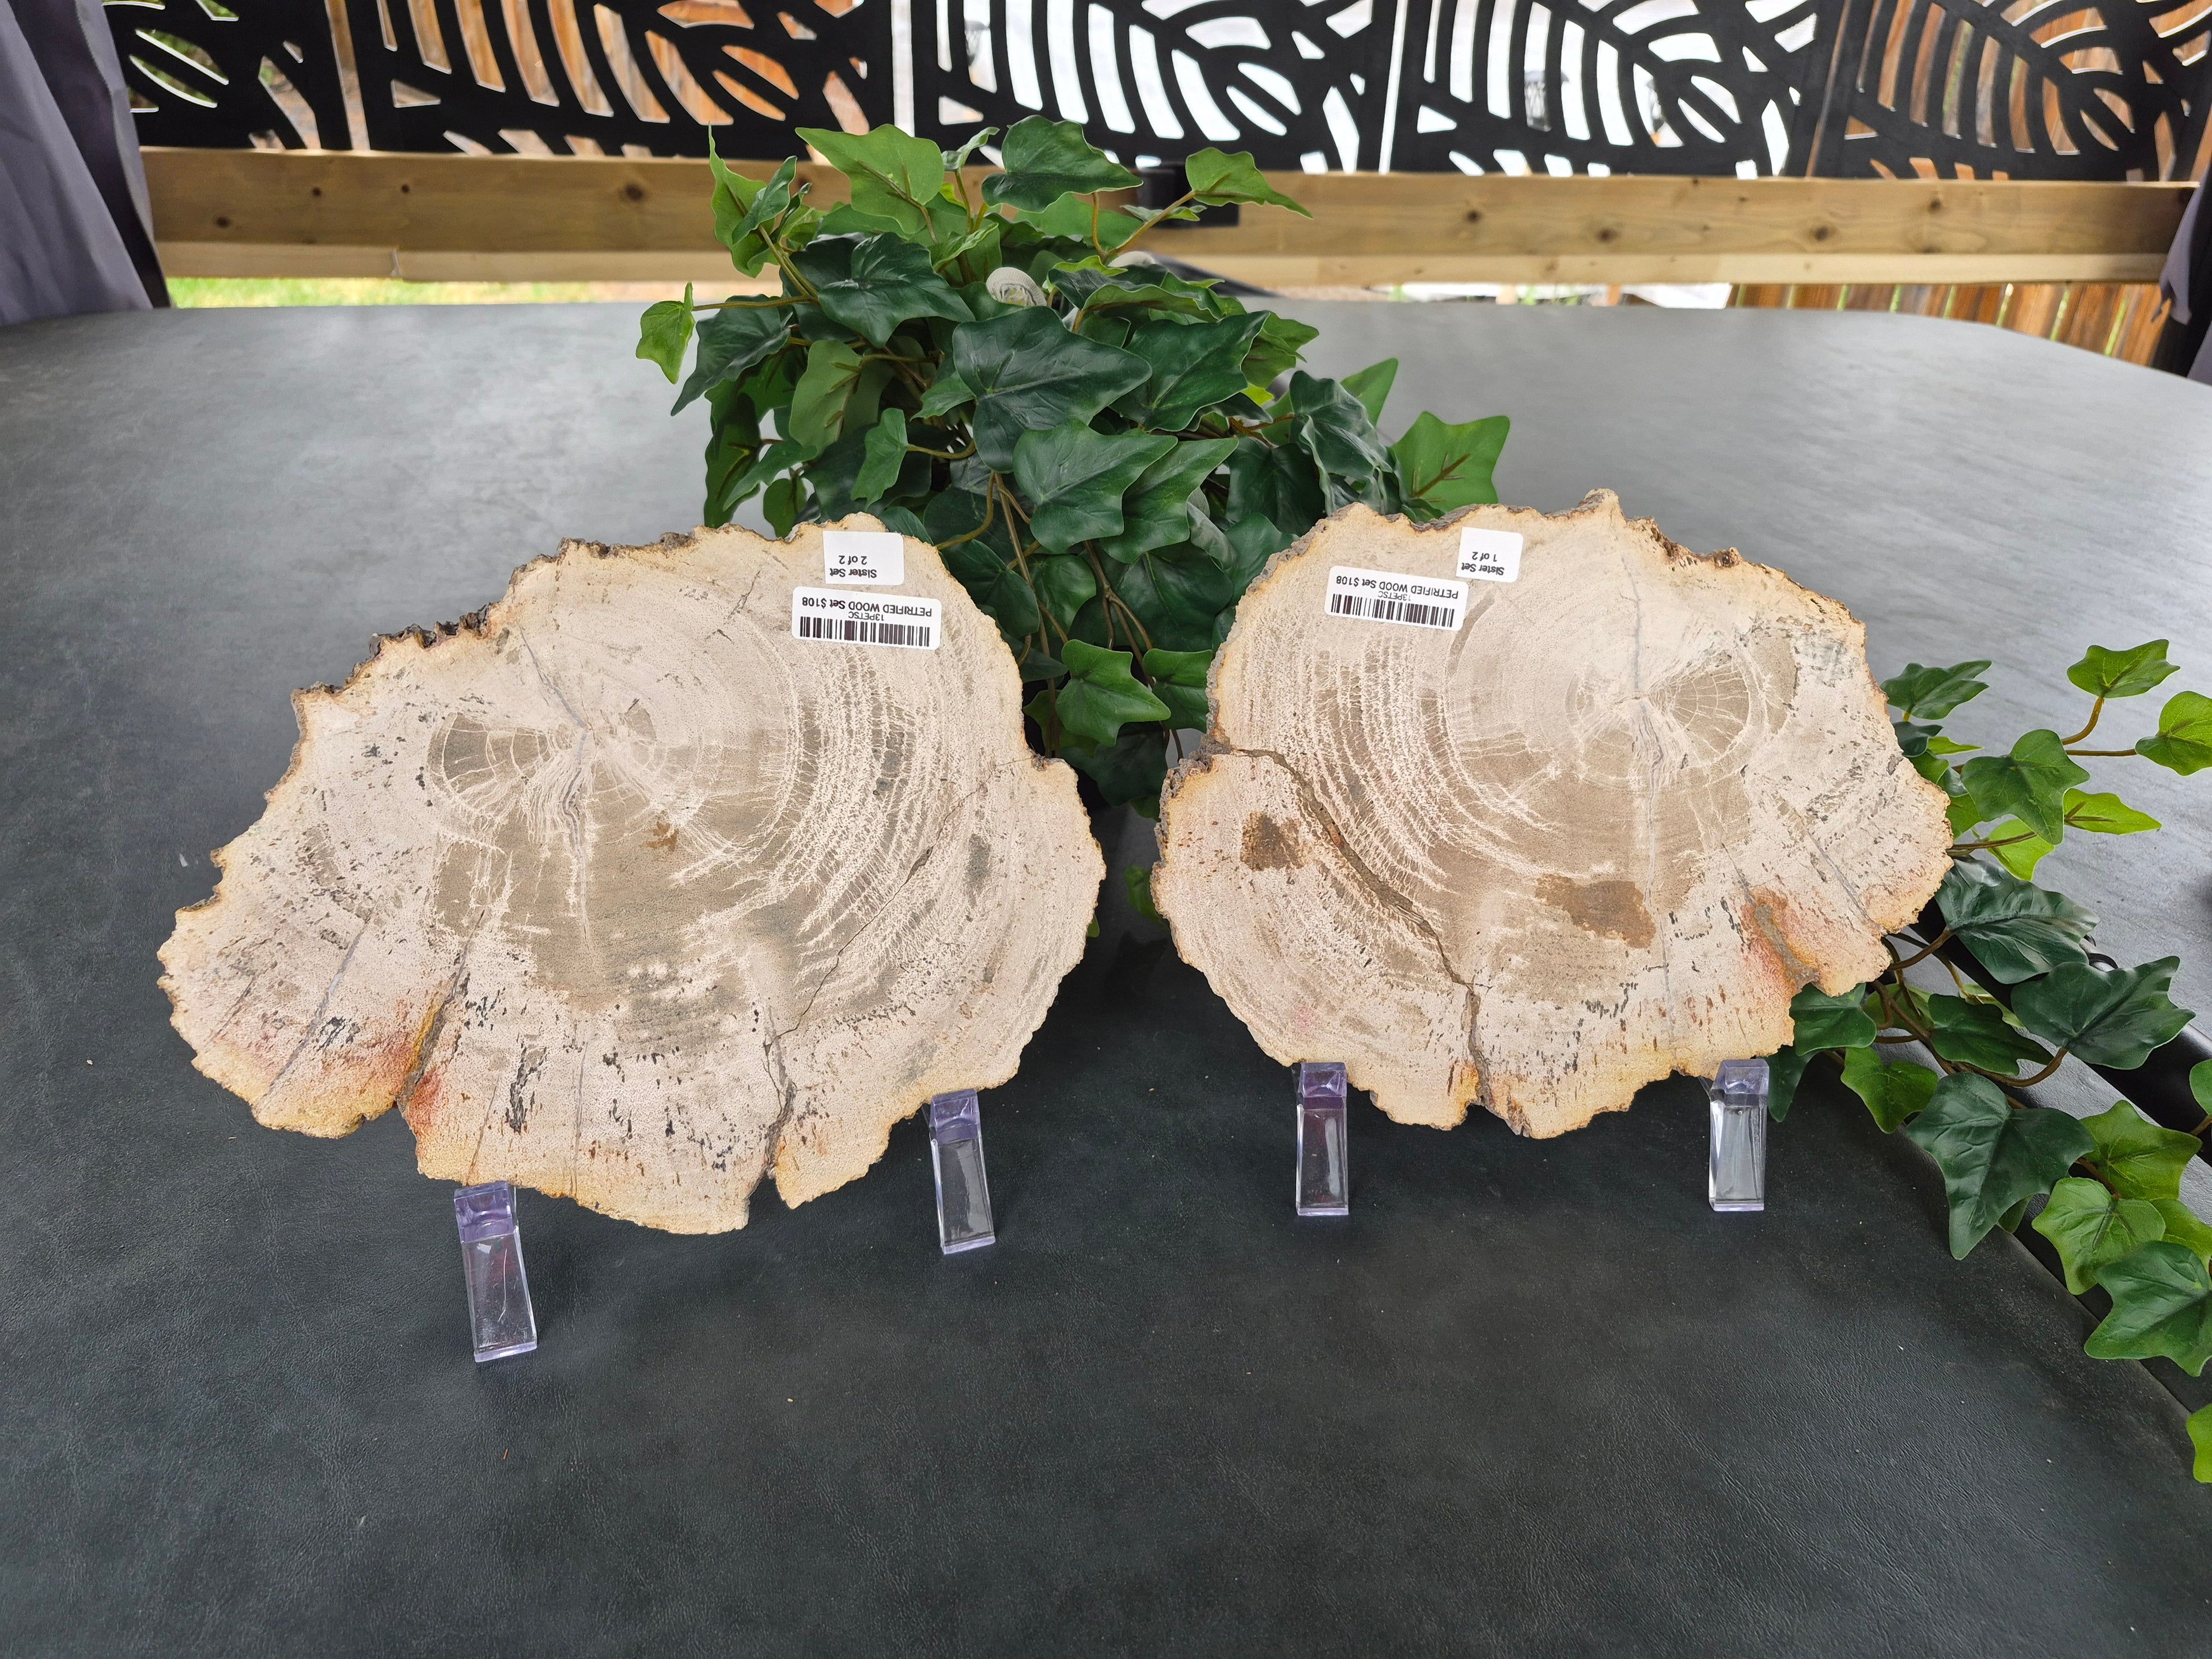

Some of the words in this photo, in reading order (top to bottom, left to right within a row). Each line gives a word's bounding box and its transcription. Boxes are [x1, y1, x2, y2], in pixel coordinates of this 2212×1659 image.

[839, 555, 846, 565] 2
[848, 555, 858, 565] of
[861, 555, 868, 565] 2
[1472, 551, 1478, 560] 2
[1480, 552, 1490, 561] of
[1493, 554, 1498, 562] 1
[1461, 562, 1476, 572] Set
[1479, 565, 1505, 575] Sister
[830, 568, 846, 577] Set
[849, 568, 877, 578] Sister
[1336, 575, 1359, 587] $108
[1362, 578, 1377, 589] Set
[1379, 582, 1408, 593] WOOD
[1411, 585, 1459, 599] PETRIFIED
[1378, 590, 1411, 601] 13PETSC
[802, 597, 827, 609] $108
[830, 599, 846, 609] Set
[848, 601, 880, 612] WOOD
[883, 604, 932, 617] PETRIFIED
[848, 611, 885, 621] 13PETSC
